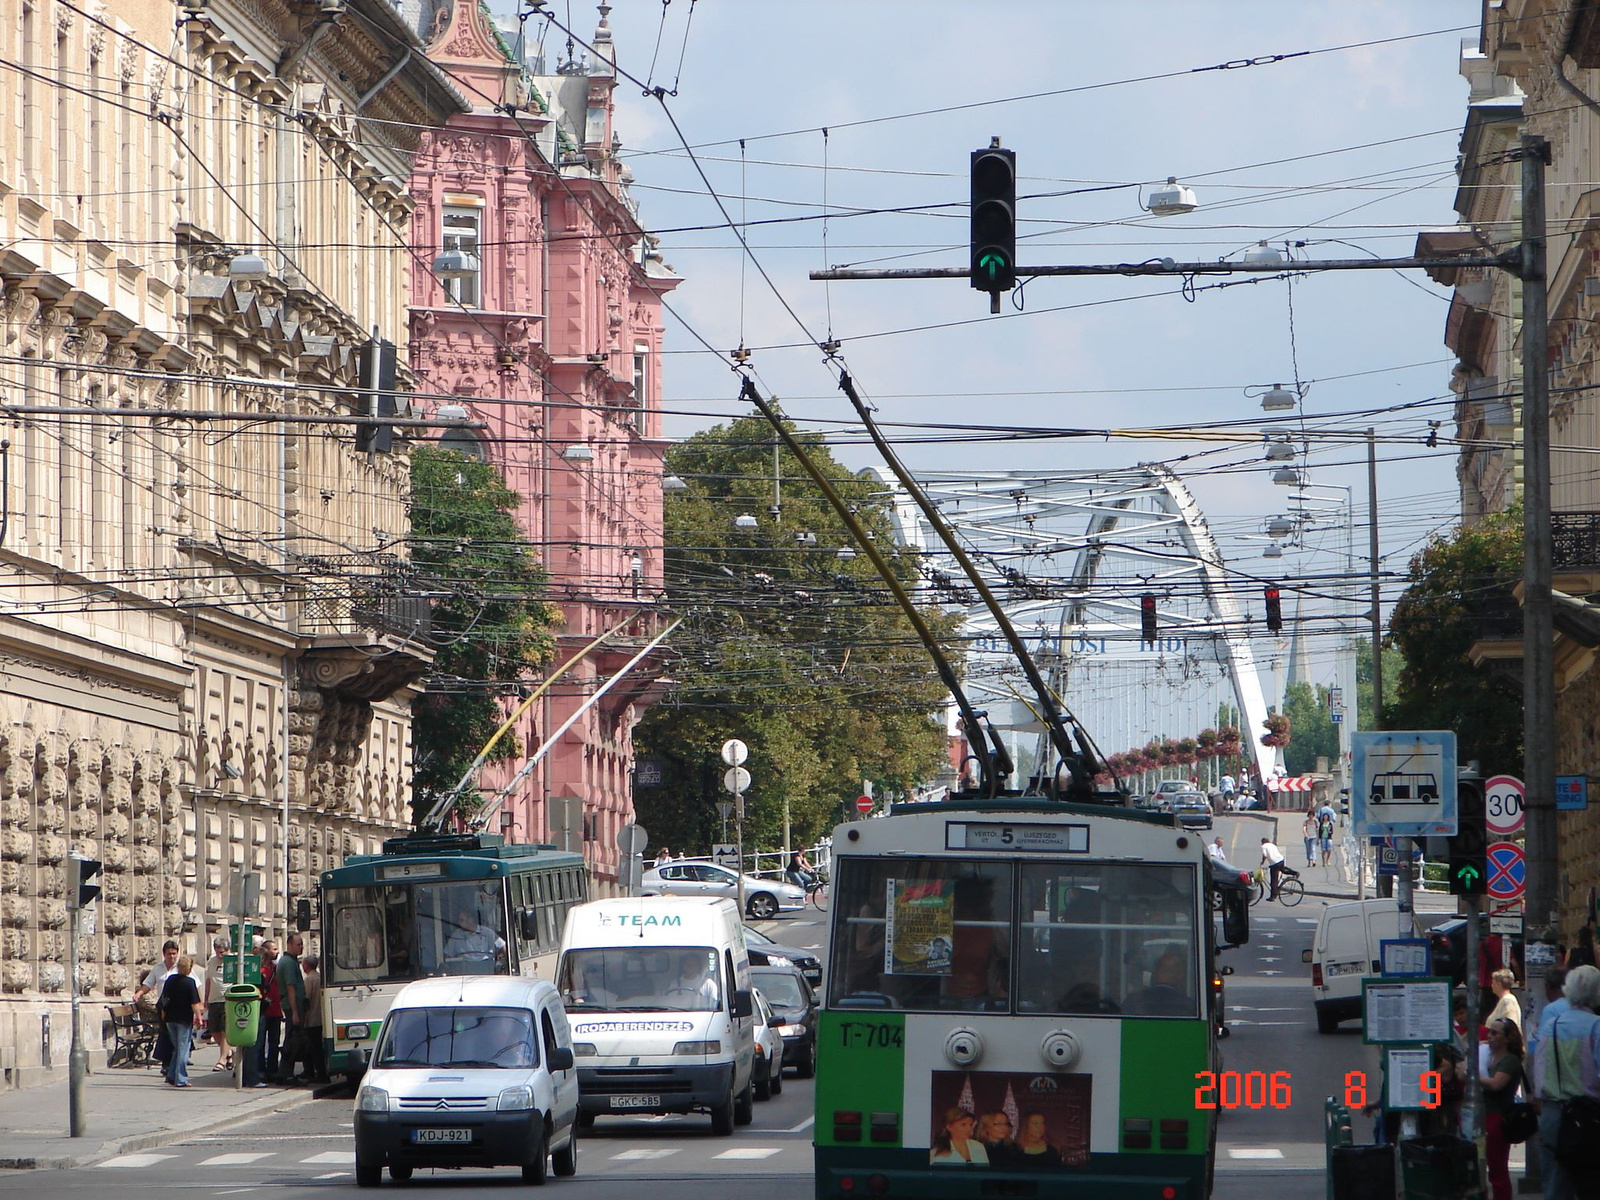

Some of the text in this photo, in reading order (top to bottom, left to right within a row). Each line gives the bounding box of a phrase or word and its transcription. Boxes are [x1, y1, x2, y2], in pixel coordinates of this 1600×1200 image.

[1557, 784, 1569, 793] TE
[1557, 794, 1582, 802] SING
[1489, 794, 1518, 816] 30
[1001, 828, 1014, 844] 5
[404, 866, 411, 876] 5
[618, 915, 682, 926] TEAM
[577, 1021, 692, 1034] IRODABERENDEZÉS
[840, 1022, 903, 1047] T-704
[618, 1096, 659, 1107] GKC-585
[419, 1130, 469, 1141] KDJ-921
